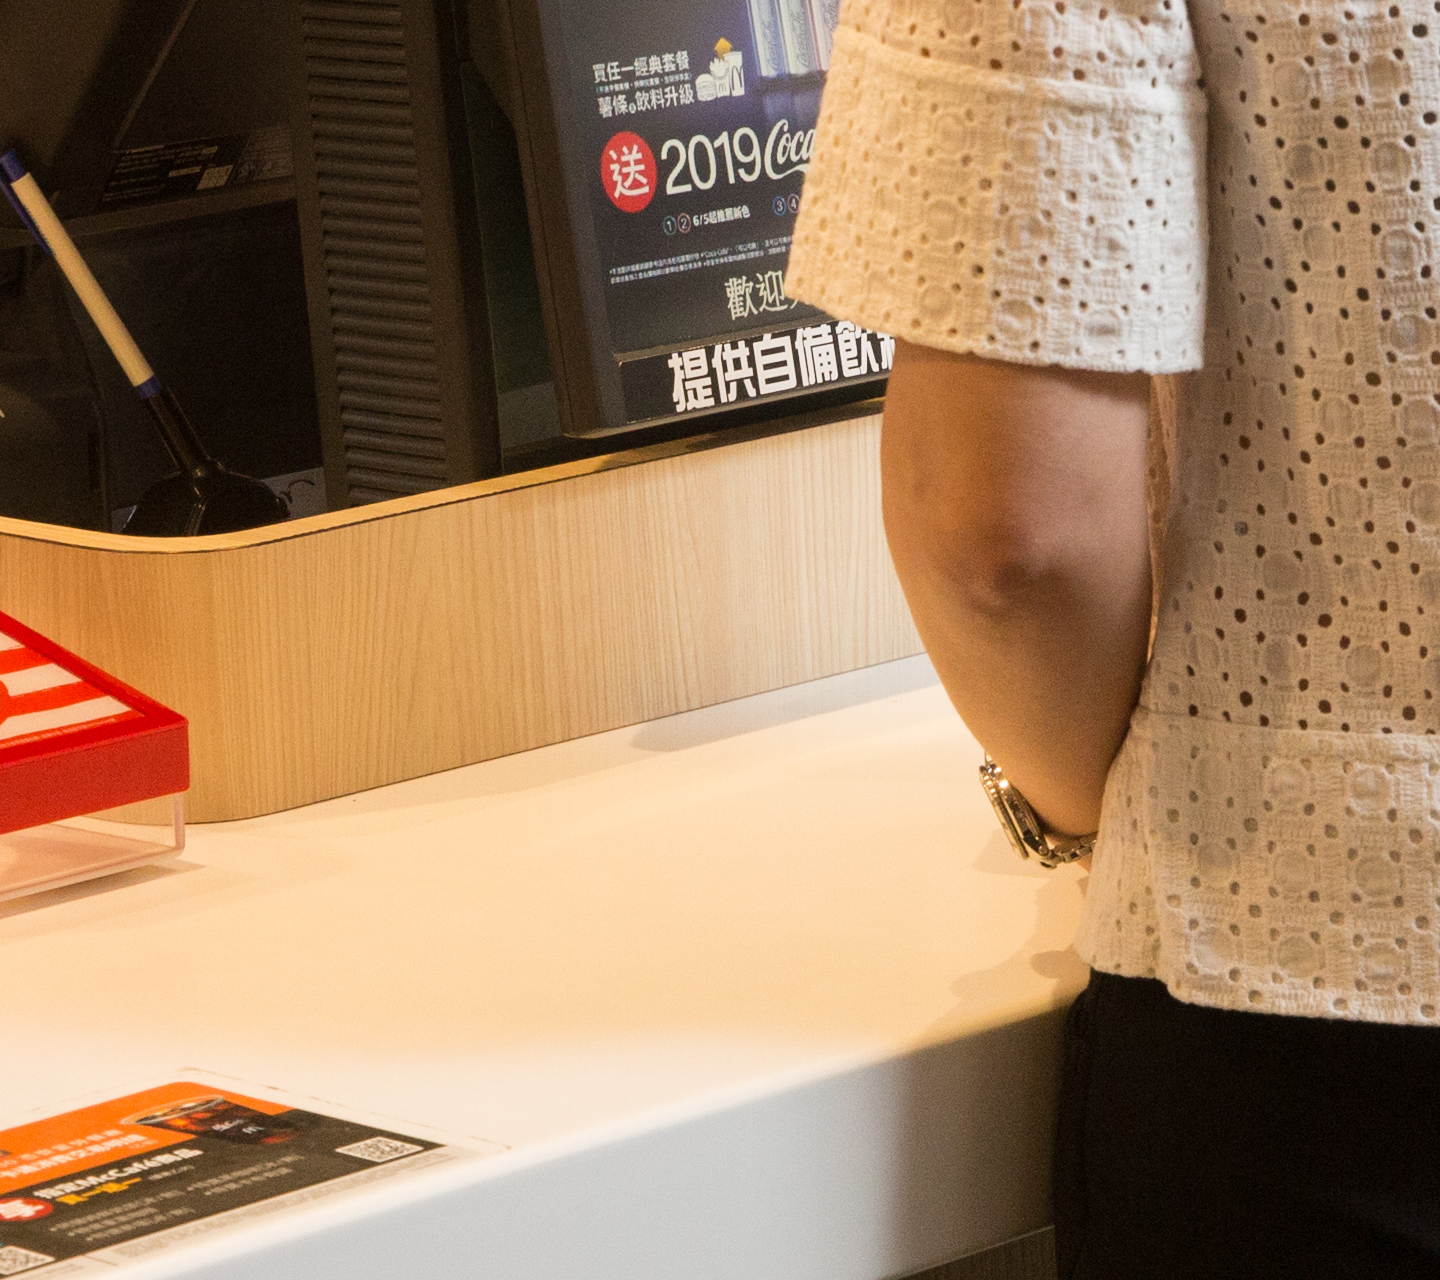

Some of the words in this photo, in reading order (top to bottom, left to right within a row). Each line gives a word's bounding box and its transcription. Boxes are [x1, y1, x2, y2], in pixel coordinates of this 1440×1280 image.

[593, 50, 690, 83] 買任一經典套餐
[608, 143, 649, 199] 送
[660, 127, 762, 195] 2019
